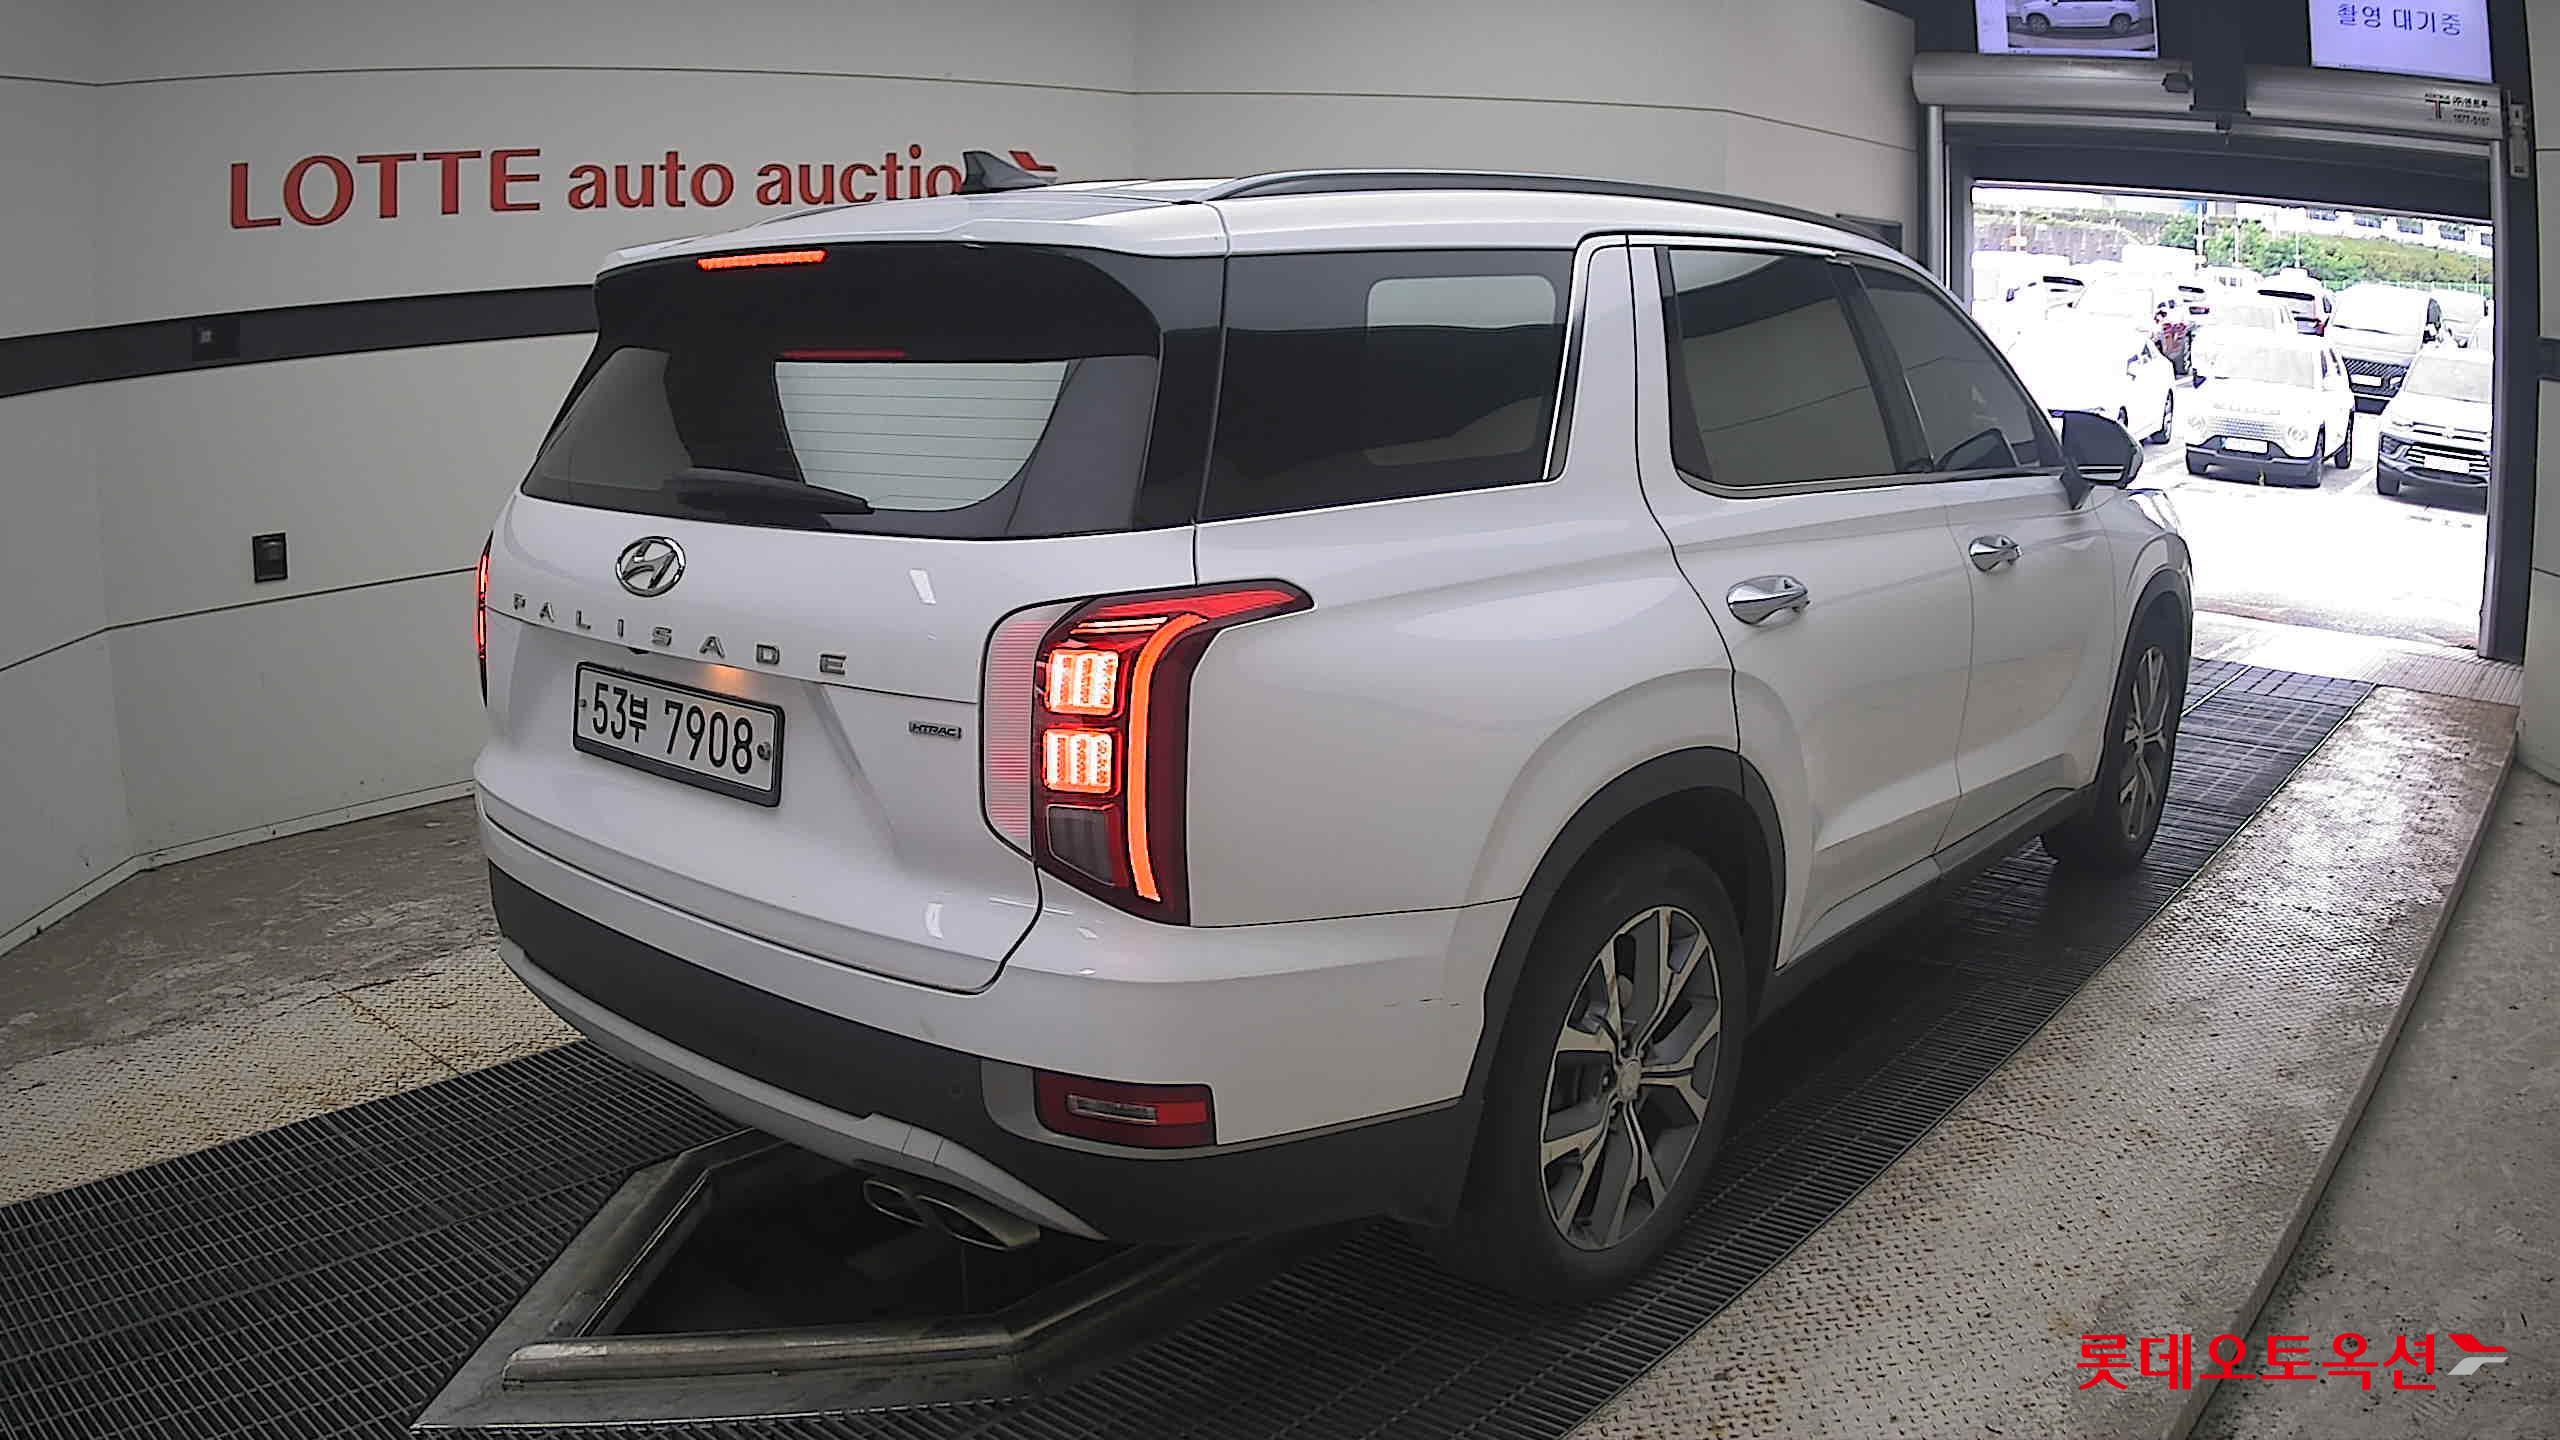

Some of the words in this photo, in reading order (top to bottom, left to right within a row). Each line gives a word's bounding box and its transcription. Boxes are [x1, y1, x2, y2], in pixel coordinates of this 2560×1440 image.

[2338, 4, 2381, 28] 촬영
[2393, 9, 2460, 36] 대기중
[231, 148, 541, 229] LOTTE
[568, 151, 734, 209] auto
[756, 143, 964, 206] auctio
[513, 593, 847, 676] PALISADE
[592, 682, 648, 743] 53부
[664, 700, 753, 775] 7908
